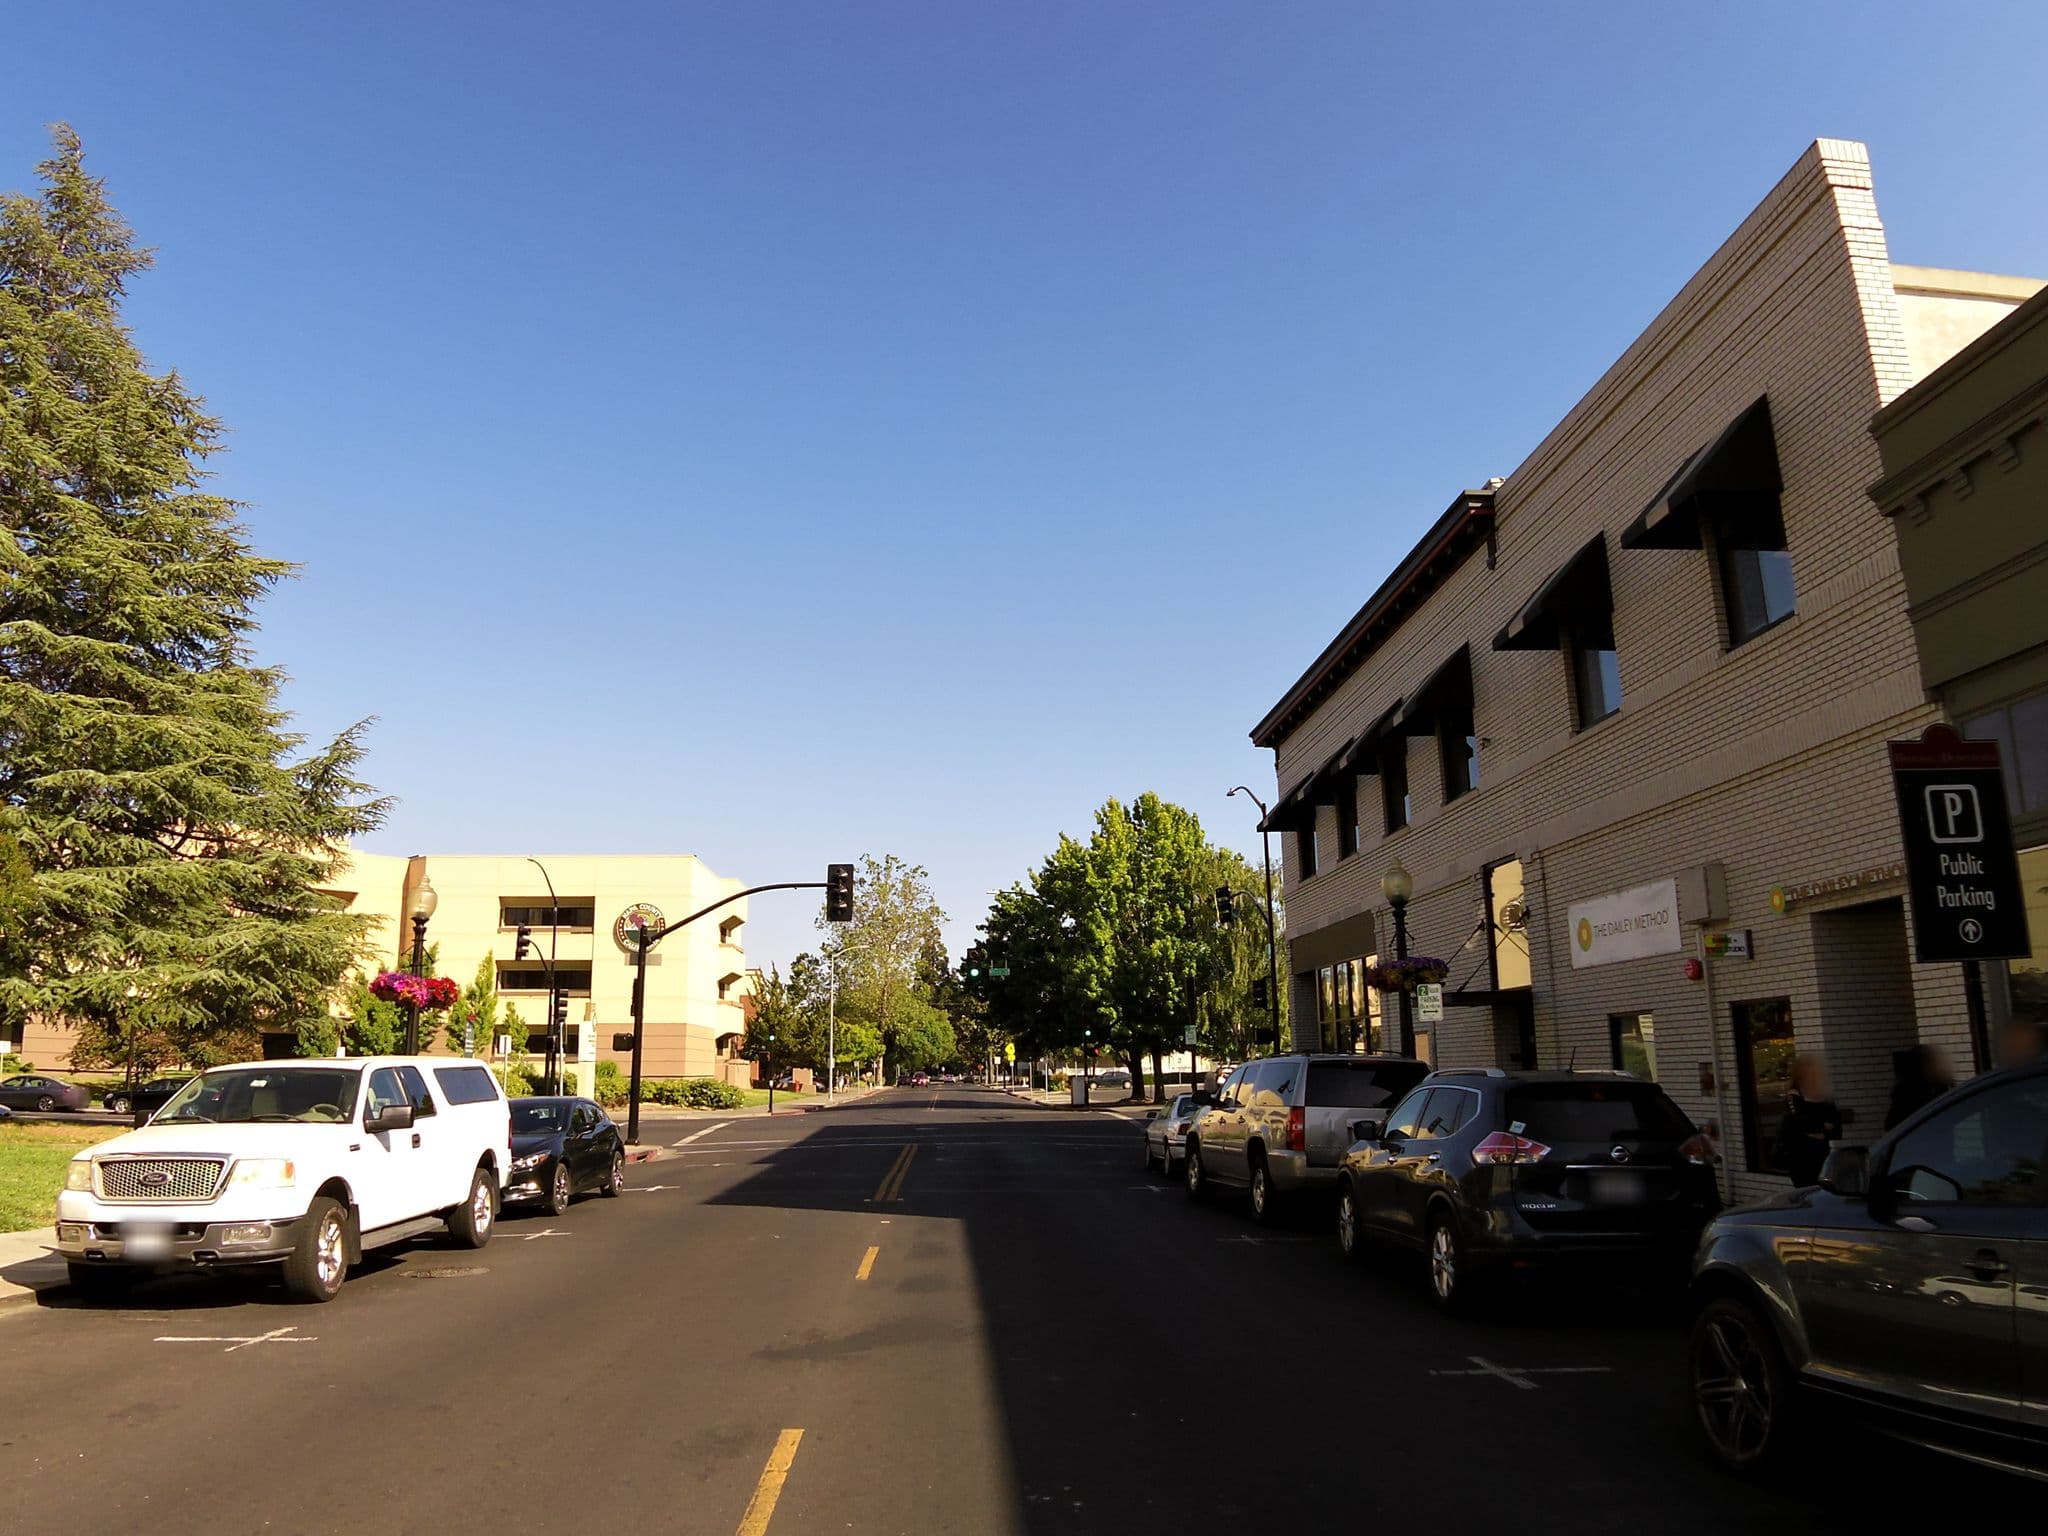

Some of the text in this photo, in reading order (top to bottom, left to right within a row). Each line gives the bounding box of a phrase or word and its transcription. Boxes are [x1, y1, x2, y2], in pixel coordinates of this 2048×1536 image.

[1944, 792, 1963, 835] P
[1939, 853, 1984, 875] Public
[639, 903, 664, 919] COUNTY
[1937, 884, 1996, 911] Parking
[1593, 923, 1607, 937] THE
[1634, 910, 1669, 929] METHOD
